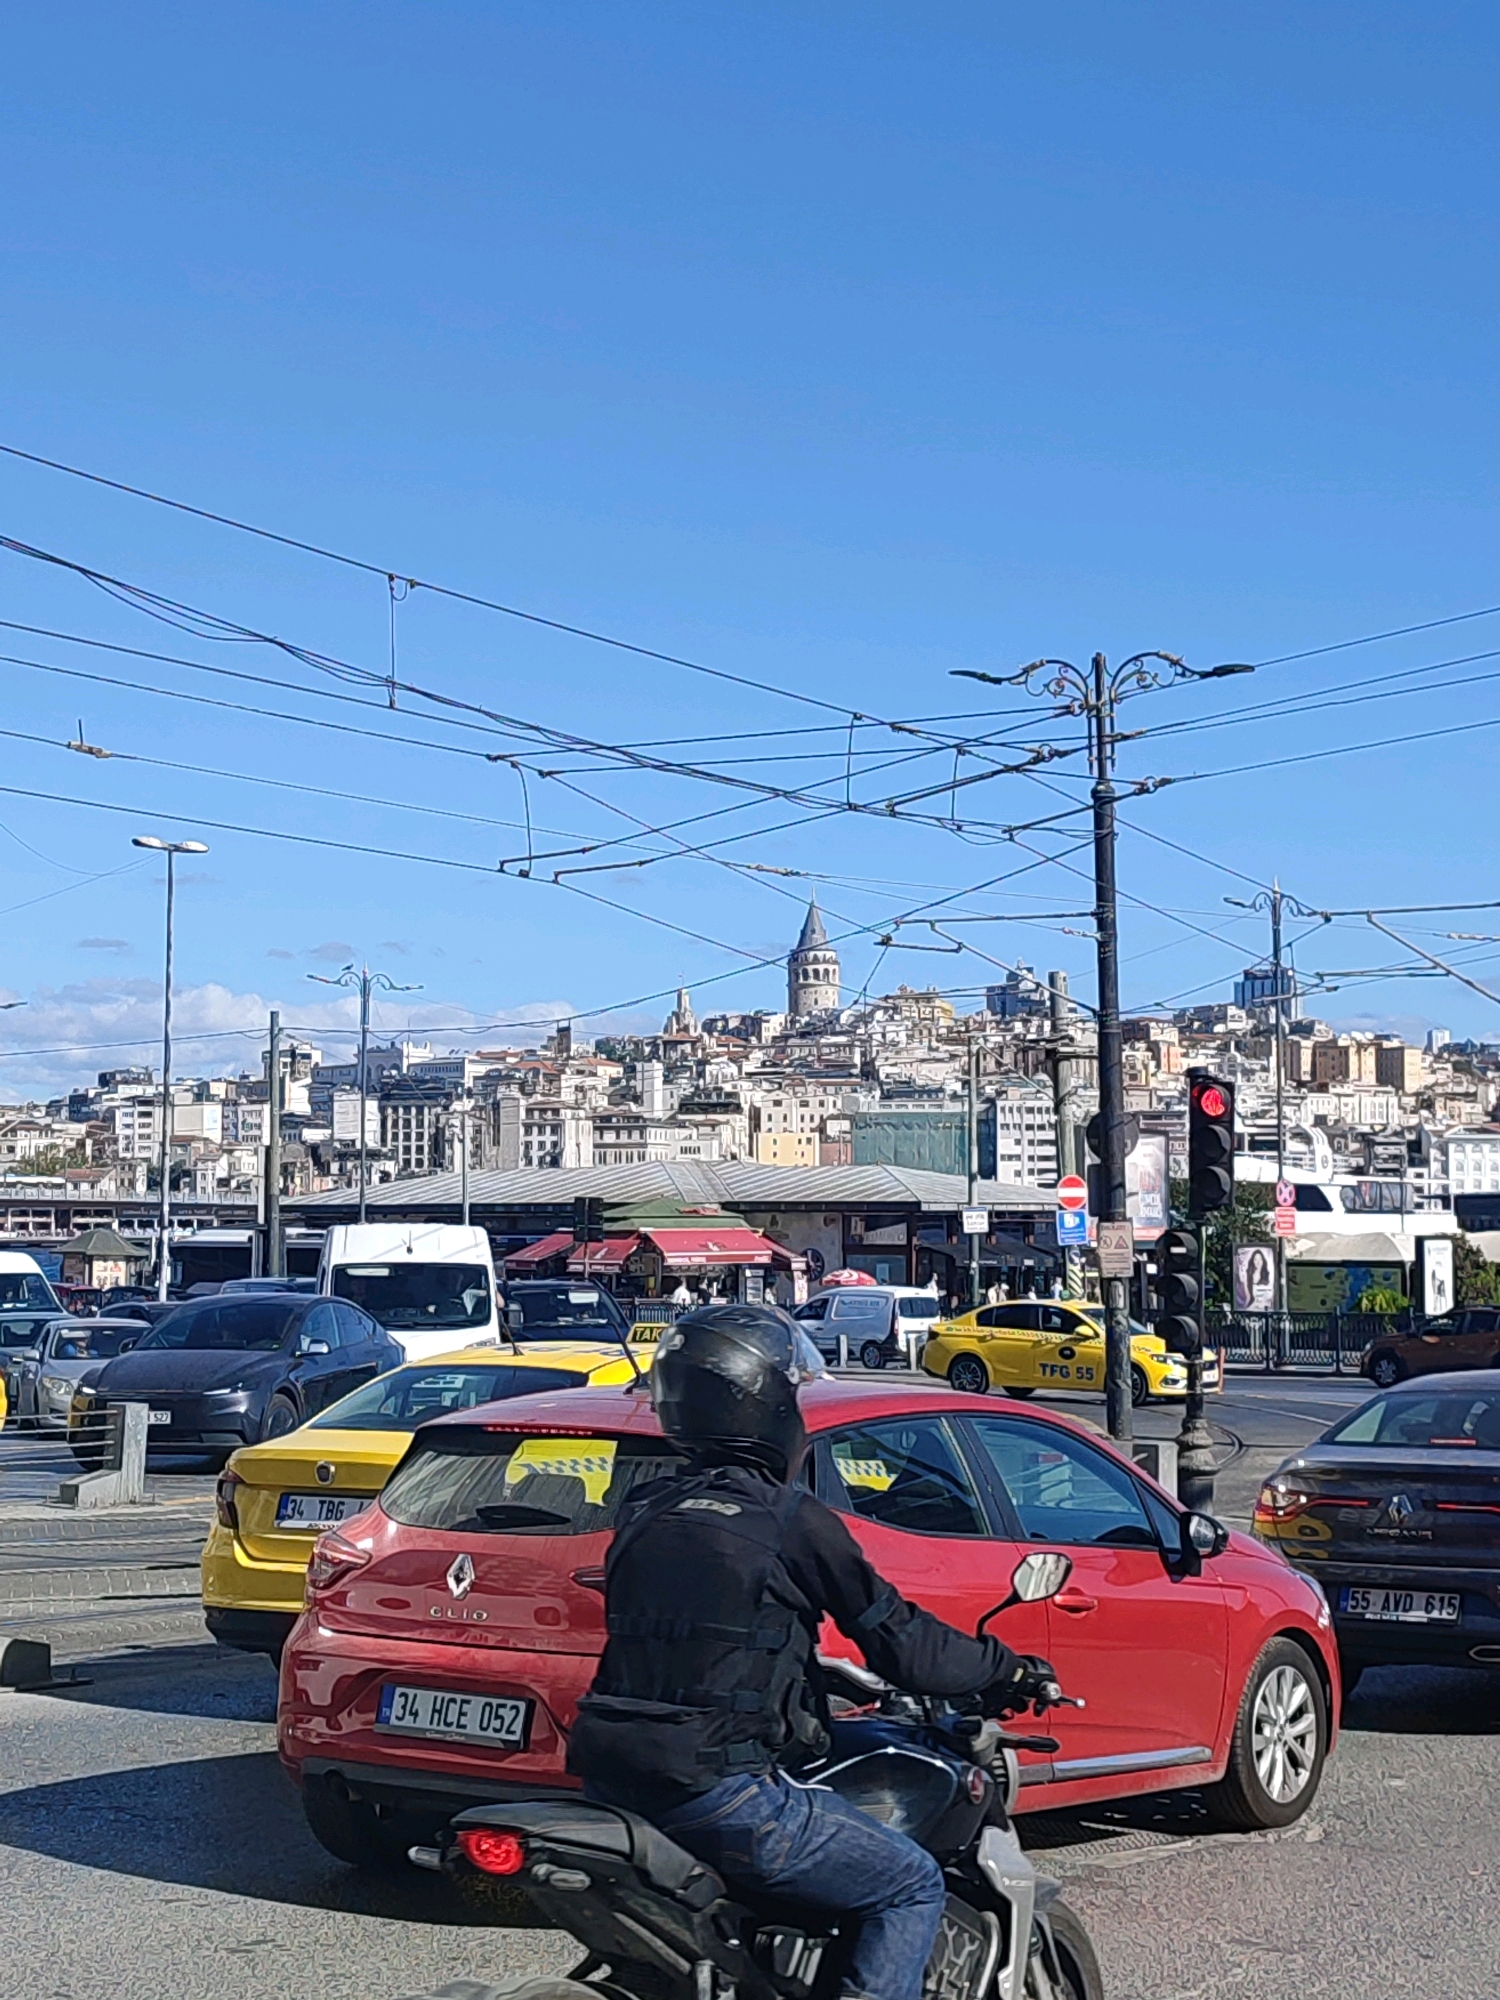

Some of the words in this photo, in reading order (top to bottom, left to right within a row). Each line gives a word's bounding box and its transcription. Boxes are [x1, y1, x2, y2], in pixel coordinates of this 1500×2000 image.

[635, 1327, 662, 1341] TAK
[1038, 1362, 1071, 1379] TFG
[1076, 1365, 1095, 1381] 55
[286, 1498, 305, 1521] 34
[317, 1499, 346, 1521] TBG
[430, 1606, 489, 1621] CLIO
[1349, 1590, 1372, 1611] 55
[1380, 1592, 1414, 1614] AVD
[1423, 1594, 1458, 1617] 615
[395, 1691, 420, 1724] 34
[429, 1694, 472, 1730] HCE
[478, 1701, 521, 1737] 052
